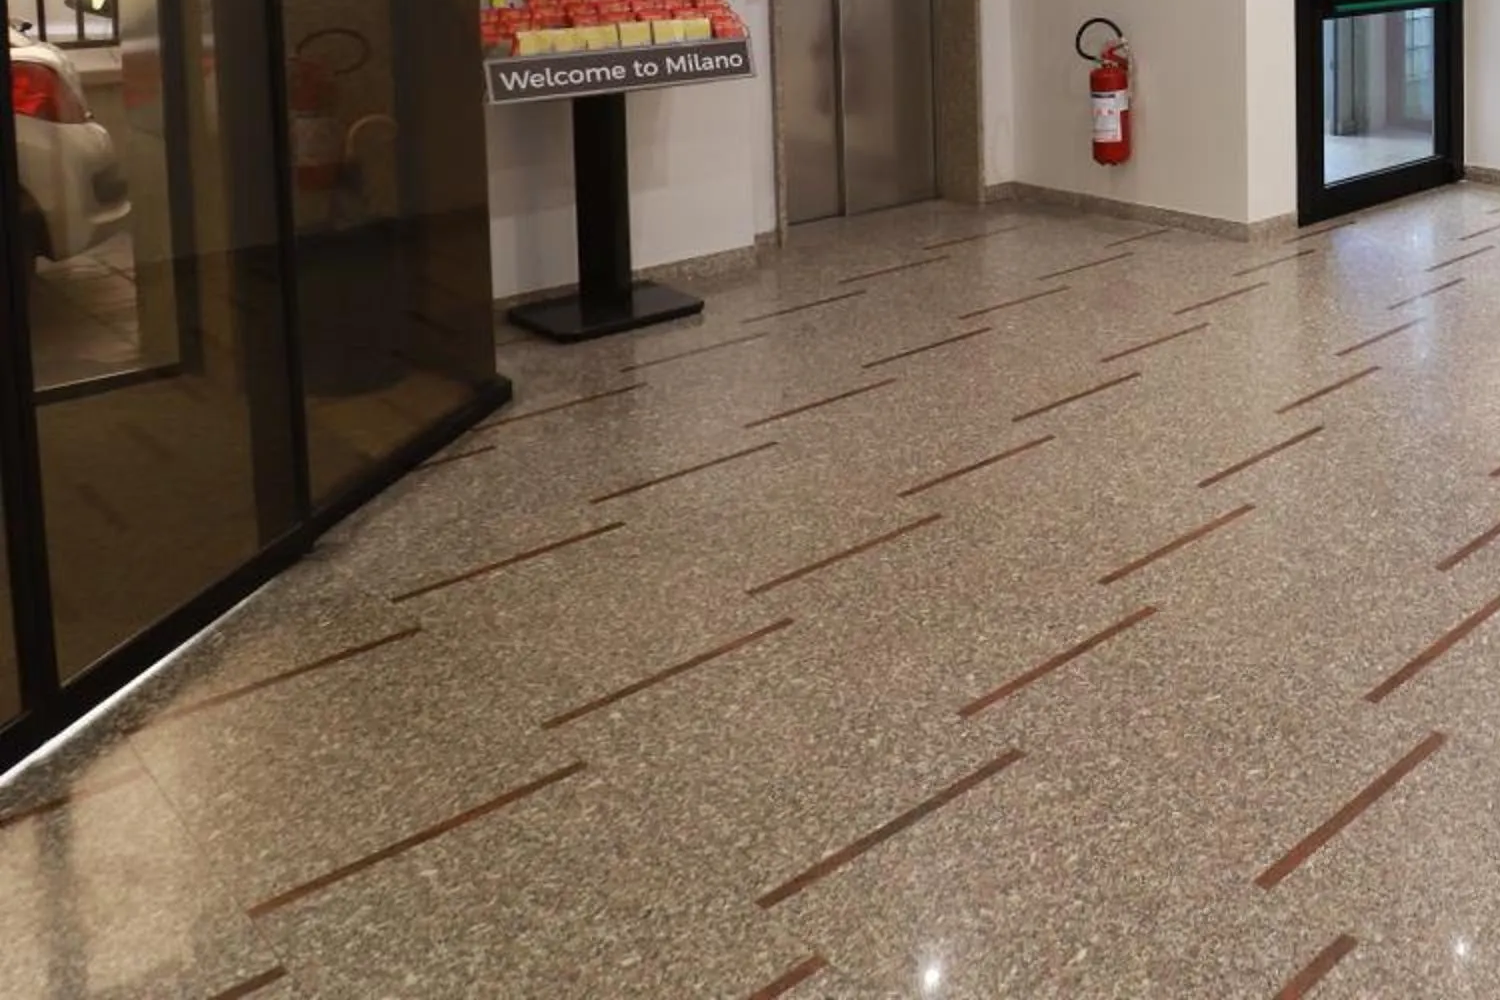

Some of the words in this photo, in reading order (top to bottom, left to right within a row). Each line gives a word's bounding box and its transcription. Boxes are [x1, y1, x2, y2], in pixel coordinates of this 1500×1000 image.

[500, 65, 626, 91] Welcome
[634, 60, 659, 77] to
[665, 53, 743, 75] Milano
